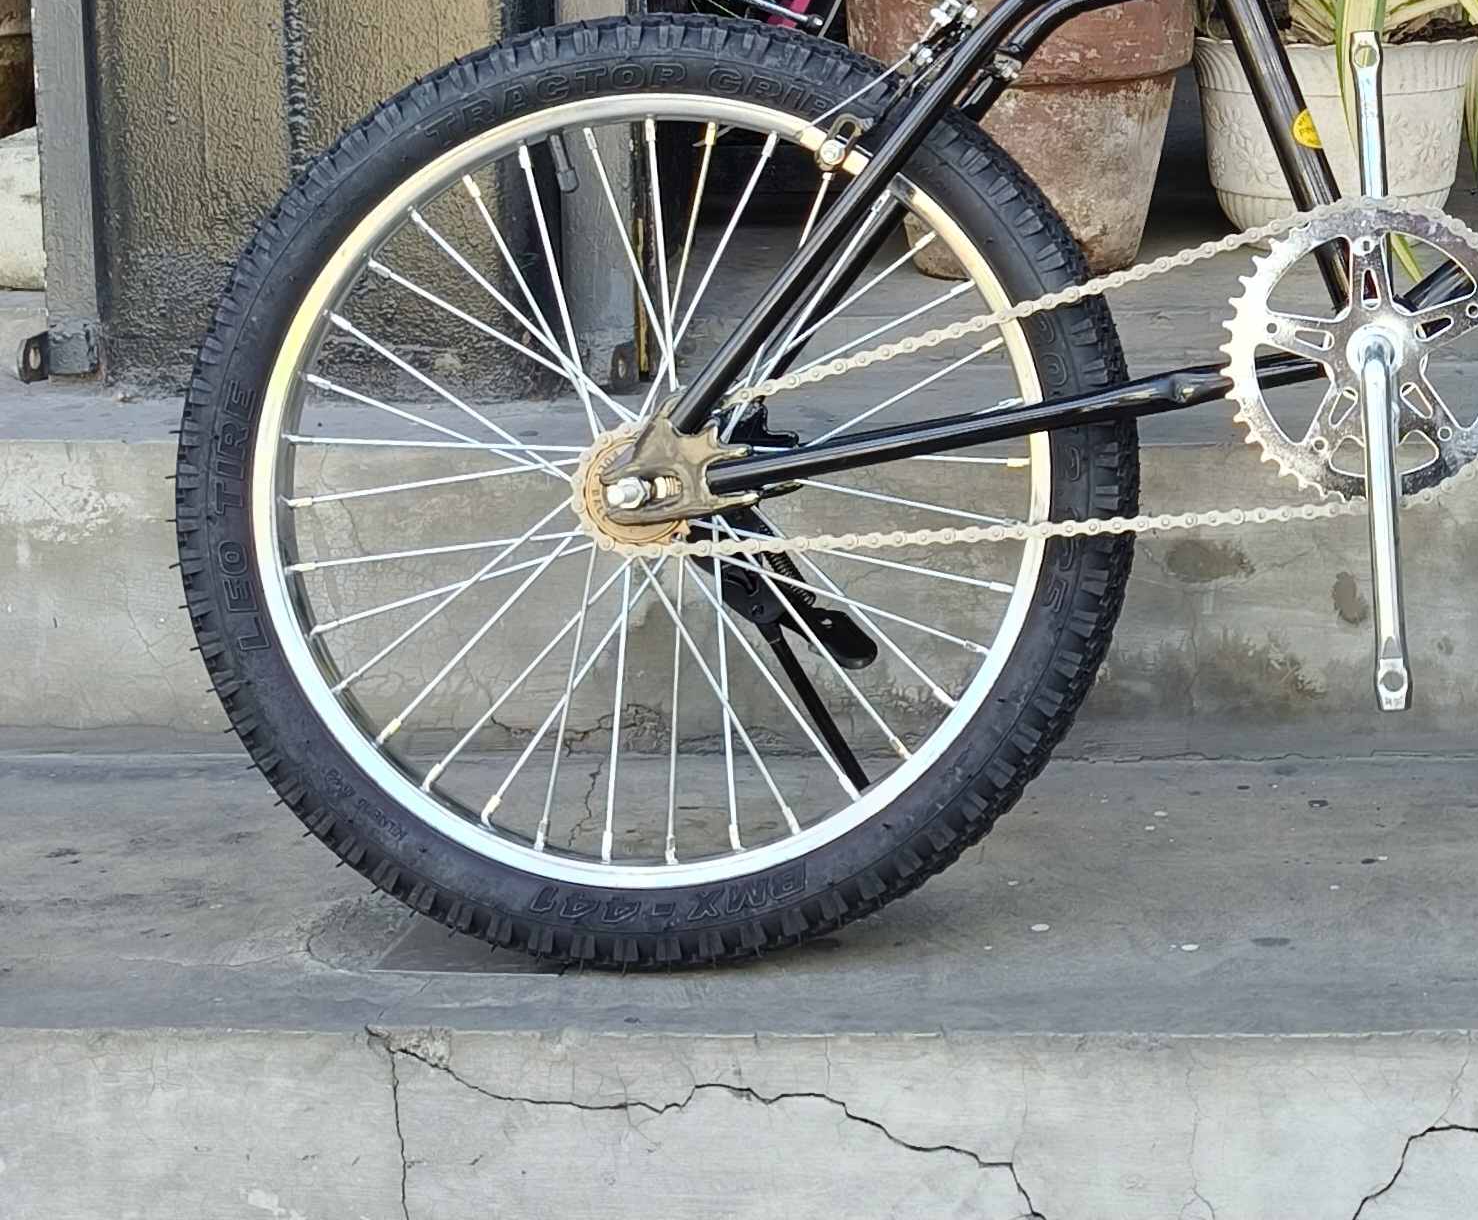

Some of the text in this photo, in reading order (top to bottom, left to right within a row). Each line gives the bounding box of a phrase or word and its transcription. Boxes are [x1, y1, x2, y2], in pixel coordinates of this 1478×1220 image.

[424, 62, 687, 146] TRACTOR
[213, 380, 272, 652] LEO TIRE
